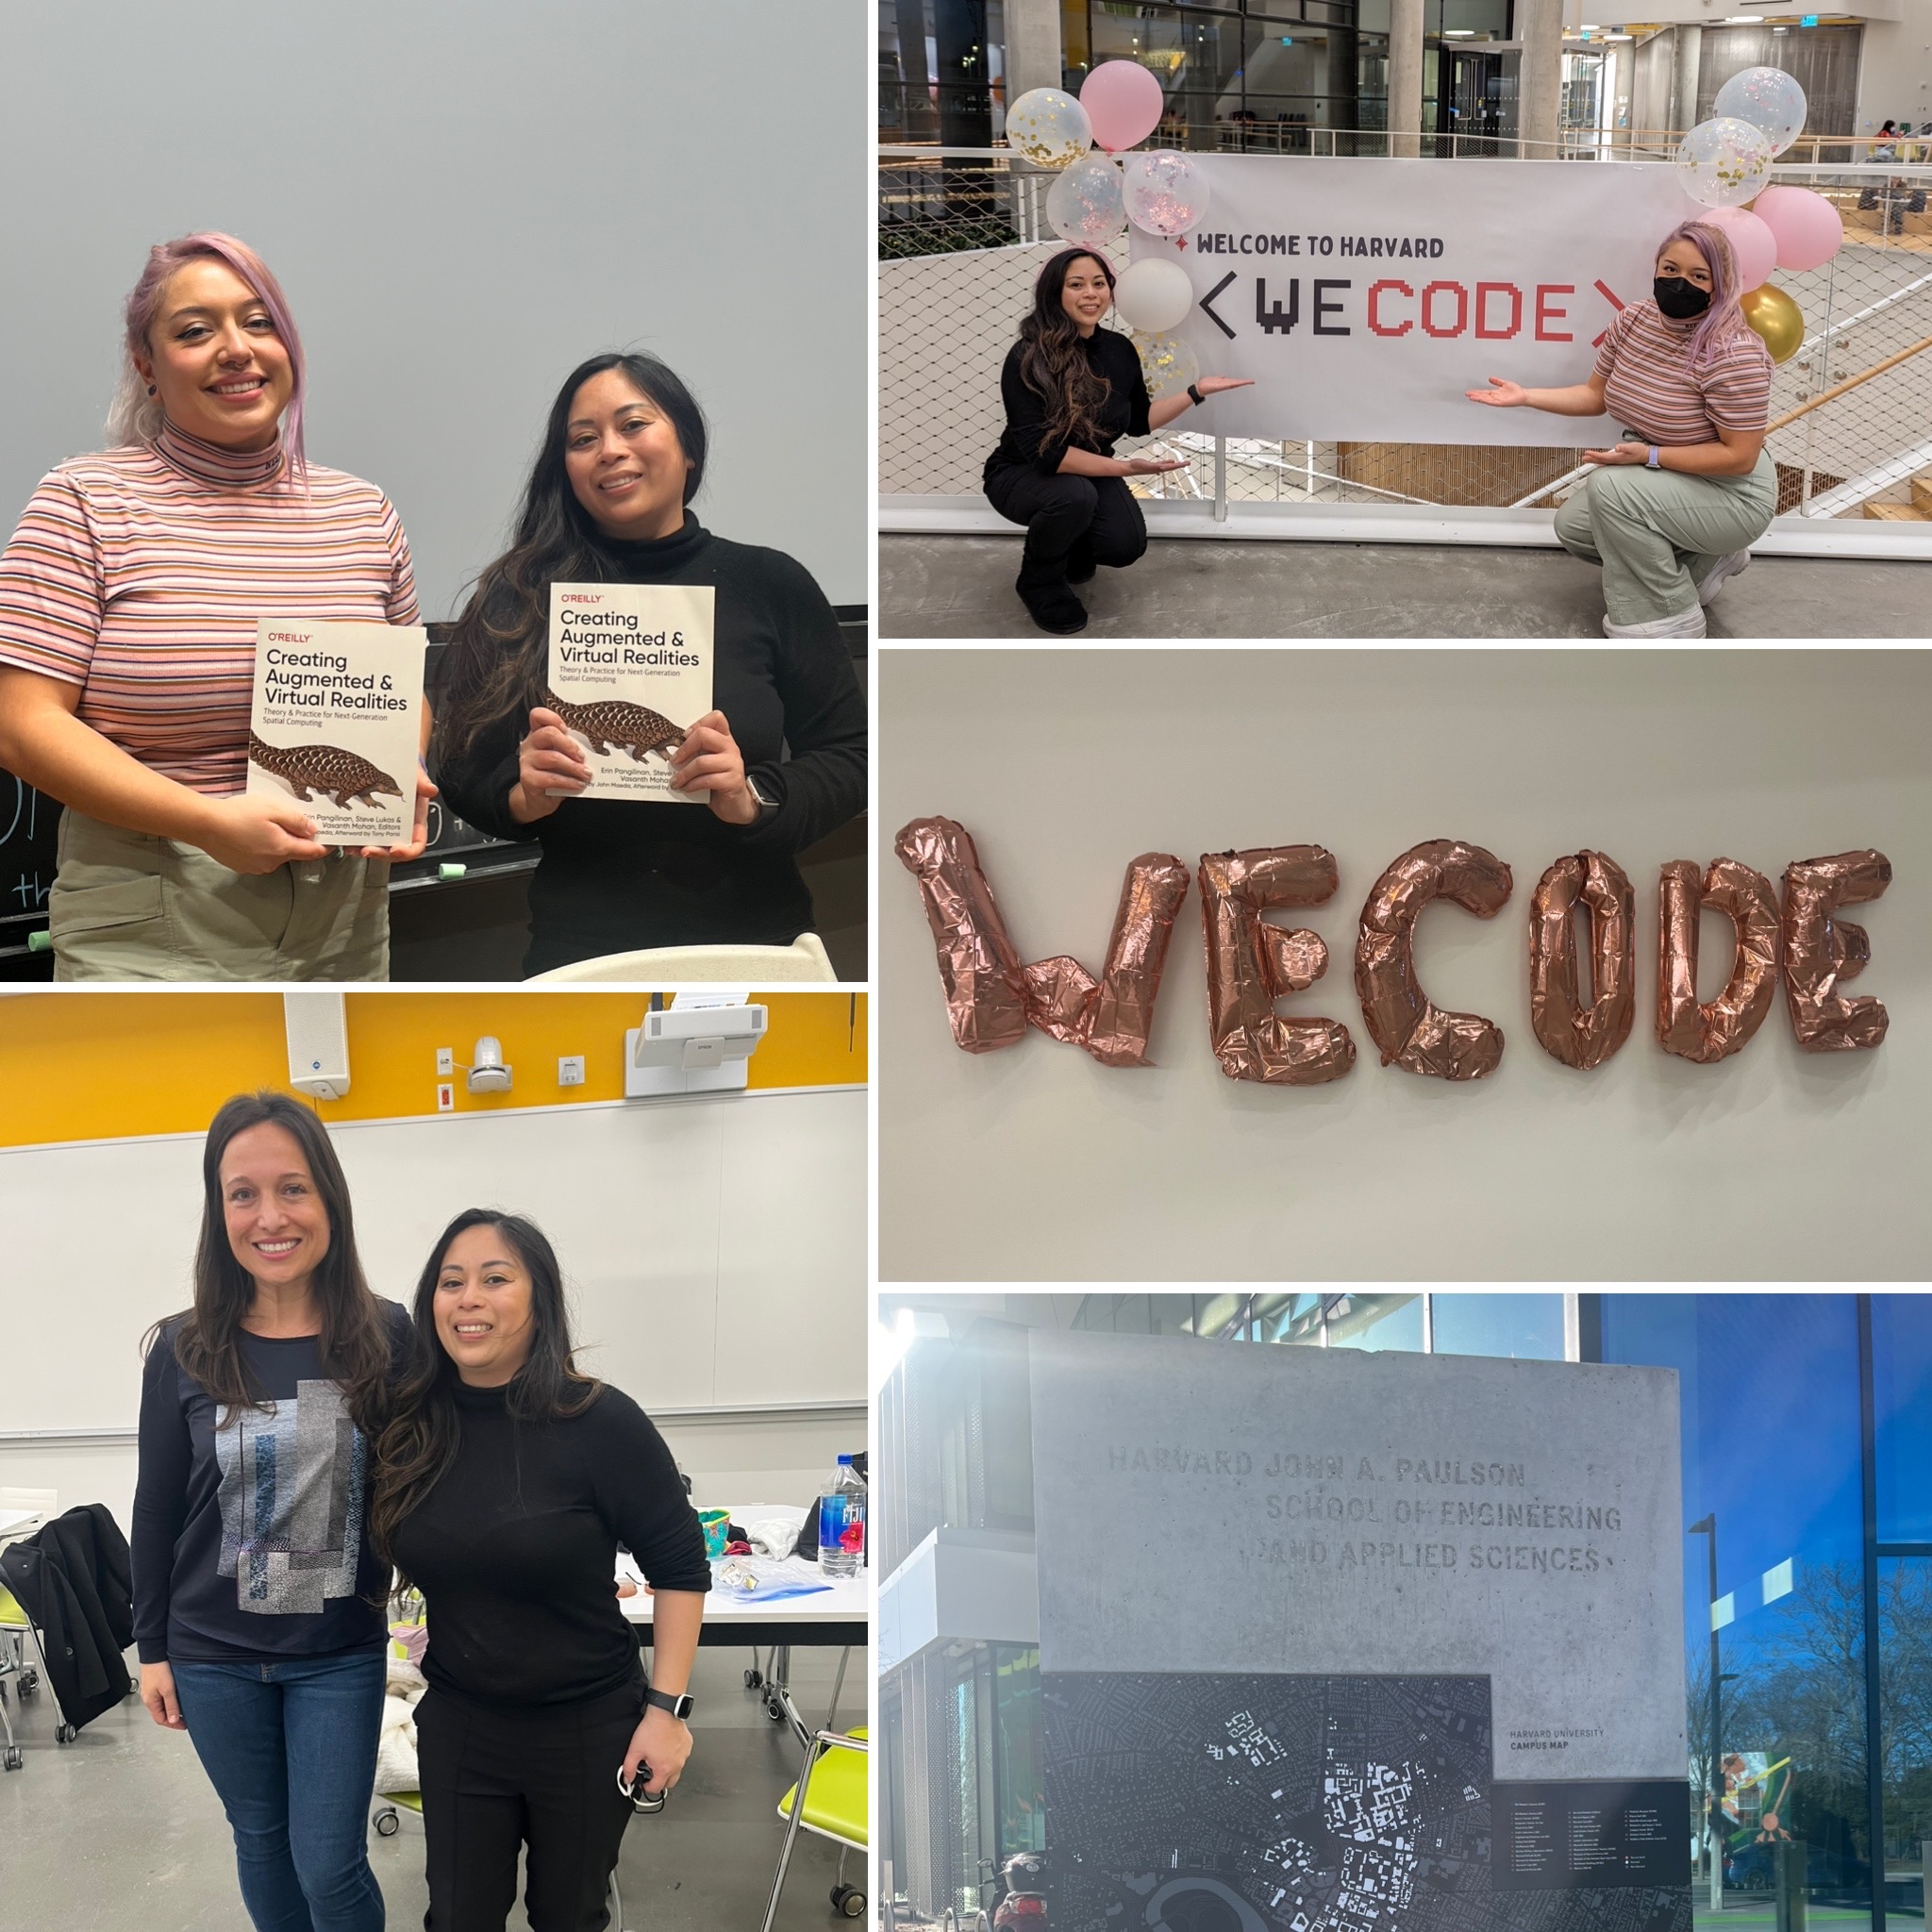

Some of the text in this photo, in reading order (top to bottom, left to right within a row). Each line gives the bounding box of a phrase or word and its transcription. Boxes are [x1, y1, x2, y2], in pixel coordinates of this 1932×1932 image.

[1197, 233, 1444, 258] WELCOME TO HARVARD
[560, 593, 601, 604] O'REILLY
[559, 609, 639, 631] Creating
[268, 632, 311, 643] O'REILLY
[559, 628, 685, 648] Augmented &
[266, 648, 347, 673] Creating
[559, 646, 700, 666] Virtual Realities
[265, 668, 393, 691] Augmented &
[559, 665, 582, 675] Theory
[590, 667, 615, 675] Practice
[616, 667, 626, 675] for
[627, 668, 681, 677] Next-Generation
[559, 674, 617, 685] Spatial Computing
[264, 687, 408, 711] Virtual Realities
[262, 716, 323, 728] Spatial Computing
[263, 708, 287, 719] Theory
[295, 709, 322, 720] Practice
[322, 710, 333, 720] for
[334, 711, 388, 722] Next-Generation
[322, 822, 351, 830] Vasanth
[355, 815, 375, 824] Steve
[895, 814, 1892, 1088] WECODE
[1108, 1445, 1525, 1488] HARVARD JOHN A. PAULSON
[842, 1507, 862, 1524] FIJI
[1266, 1492, 1623, 1533] SCHOOL OF ENGINEERING
[1269, 1538, 1601, 1574] AND APPLIED SCIENCES
[1510, 1728, 1605, 1740] HARVARD UNIVERSITY
[1510, 1740, 1569, 1751] CAMPUS MAP
